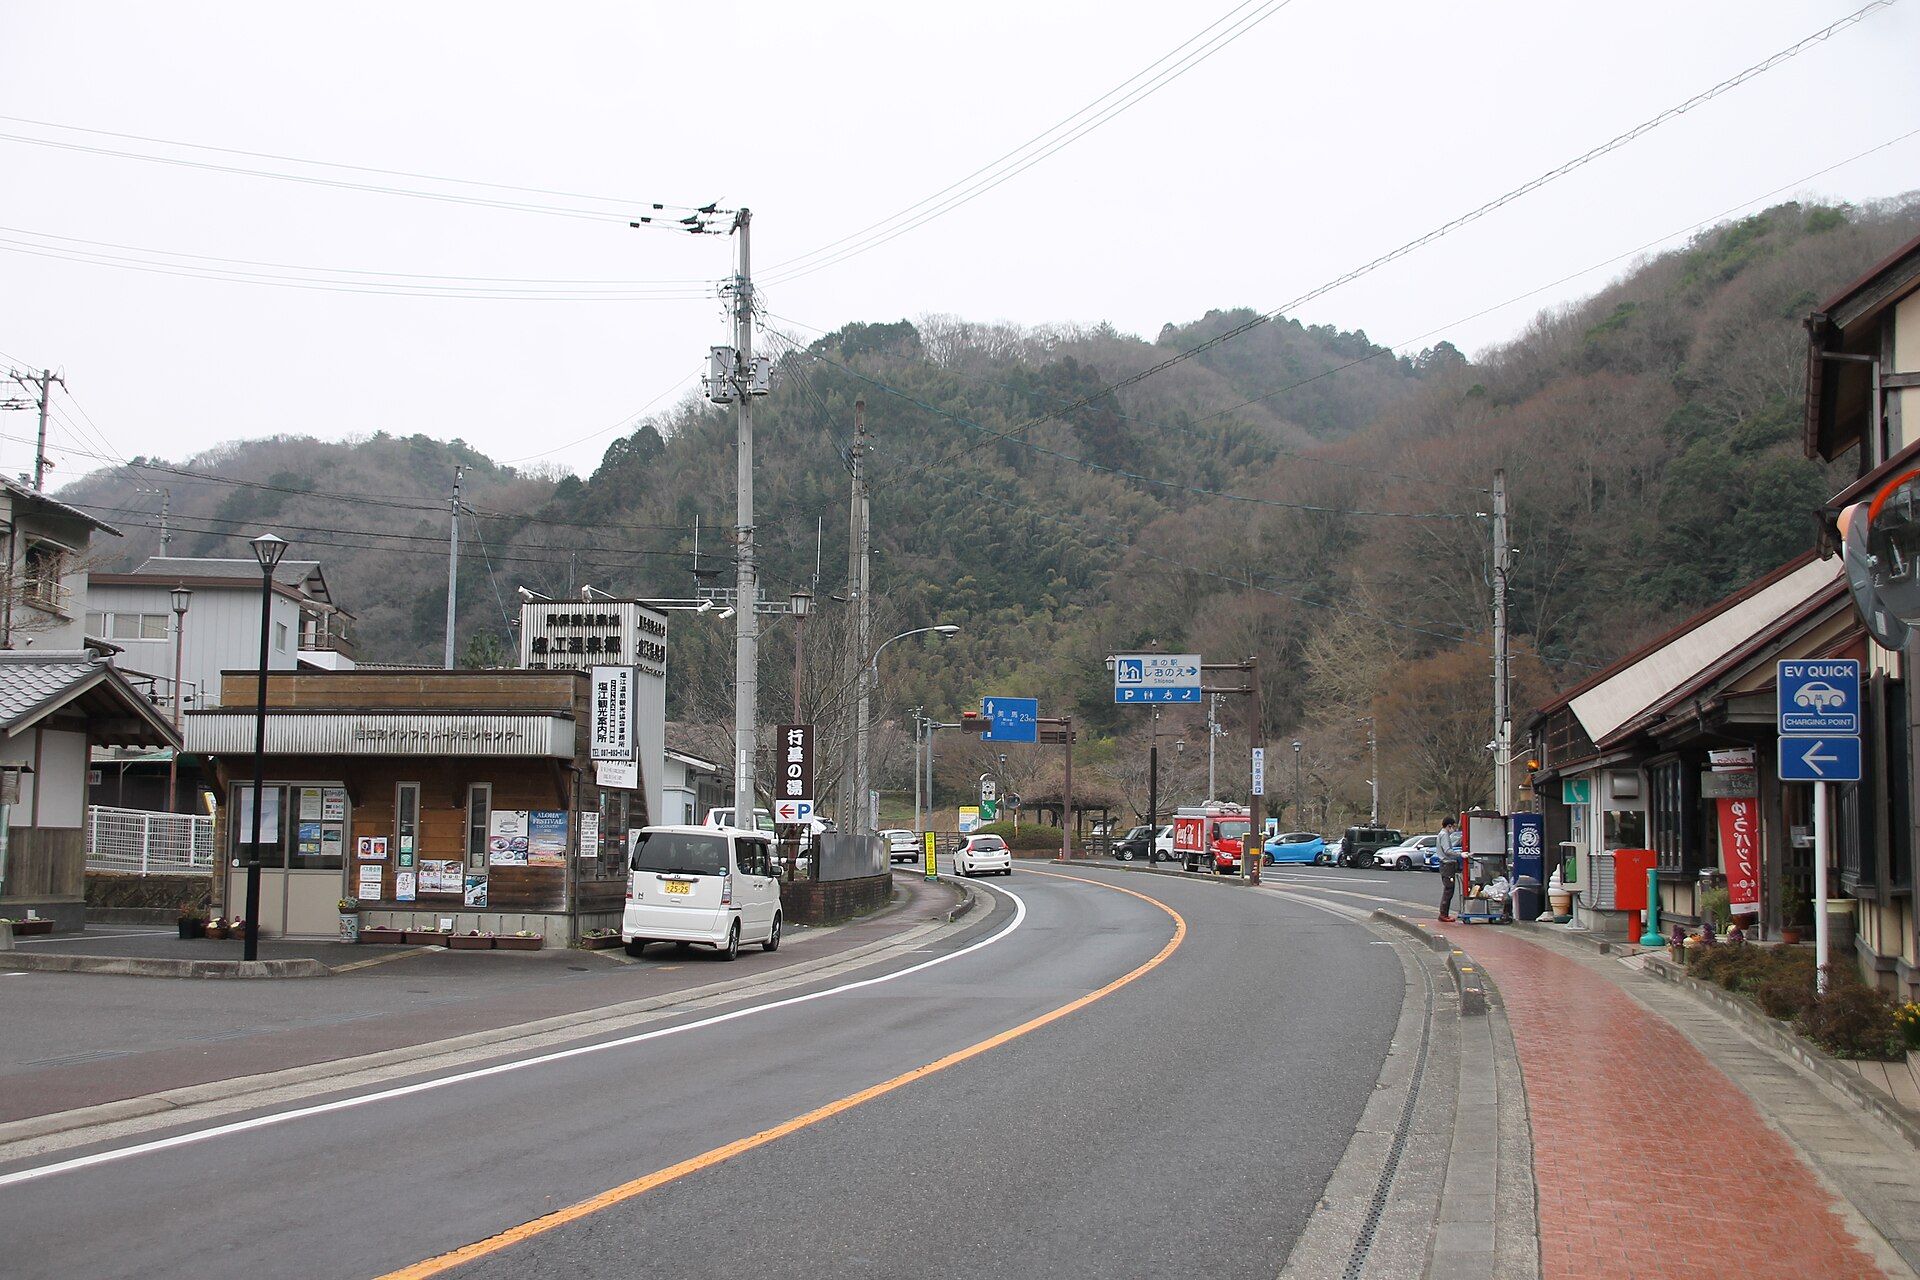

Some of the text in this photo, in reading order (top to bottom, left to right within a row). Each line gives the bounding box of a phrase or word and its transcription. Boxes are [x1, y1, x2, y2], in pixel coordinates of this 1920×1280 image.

[1151, 659, 1178, 667] 道の駅
[1144, 668, 1185, 677] しおのえ
[1784, 665, 1853, 678] EV QUICK
[597, 682, 608, 743] 塩江観光案内所
[1786, 718, 1853, 726] CHARGING POINT
[592, 748, 600, 757] TEL
[787, 728, 804, 796] 行基の湯
[797, 803, 812, 820] P
[1518, 846, 1541, 855] BOSS
